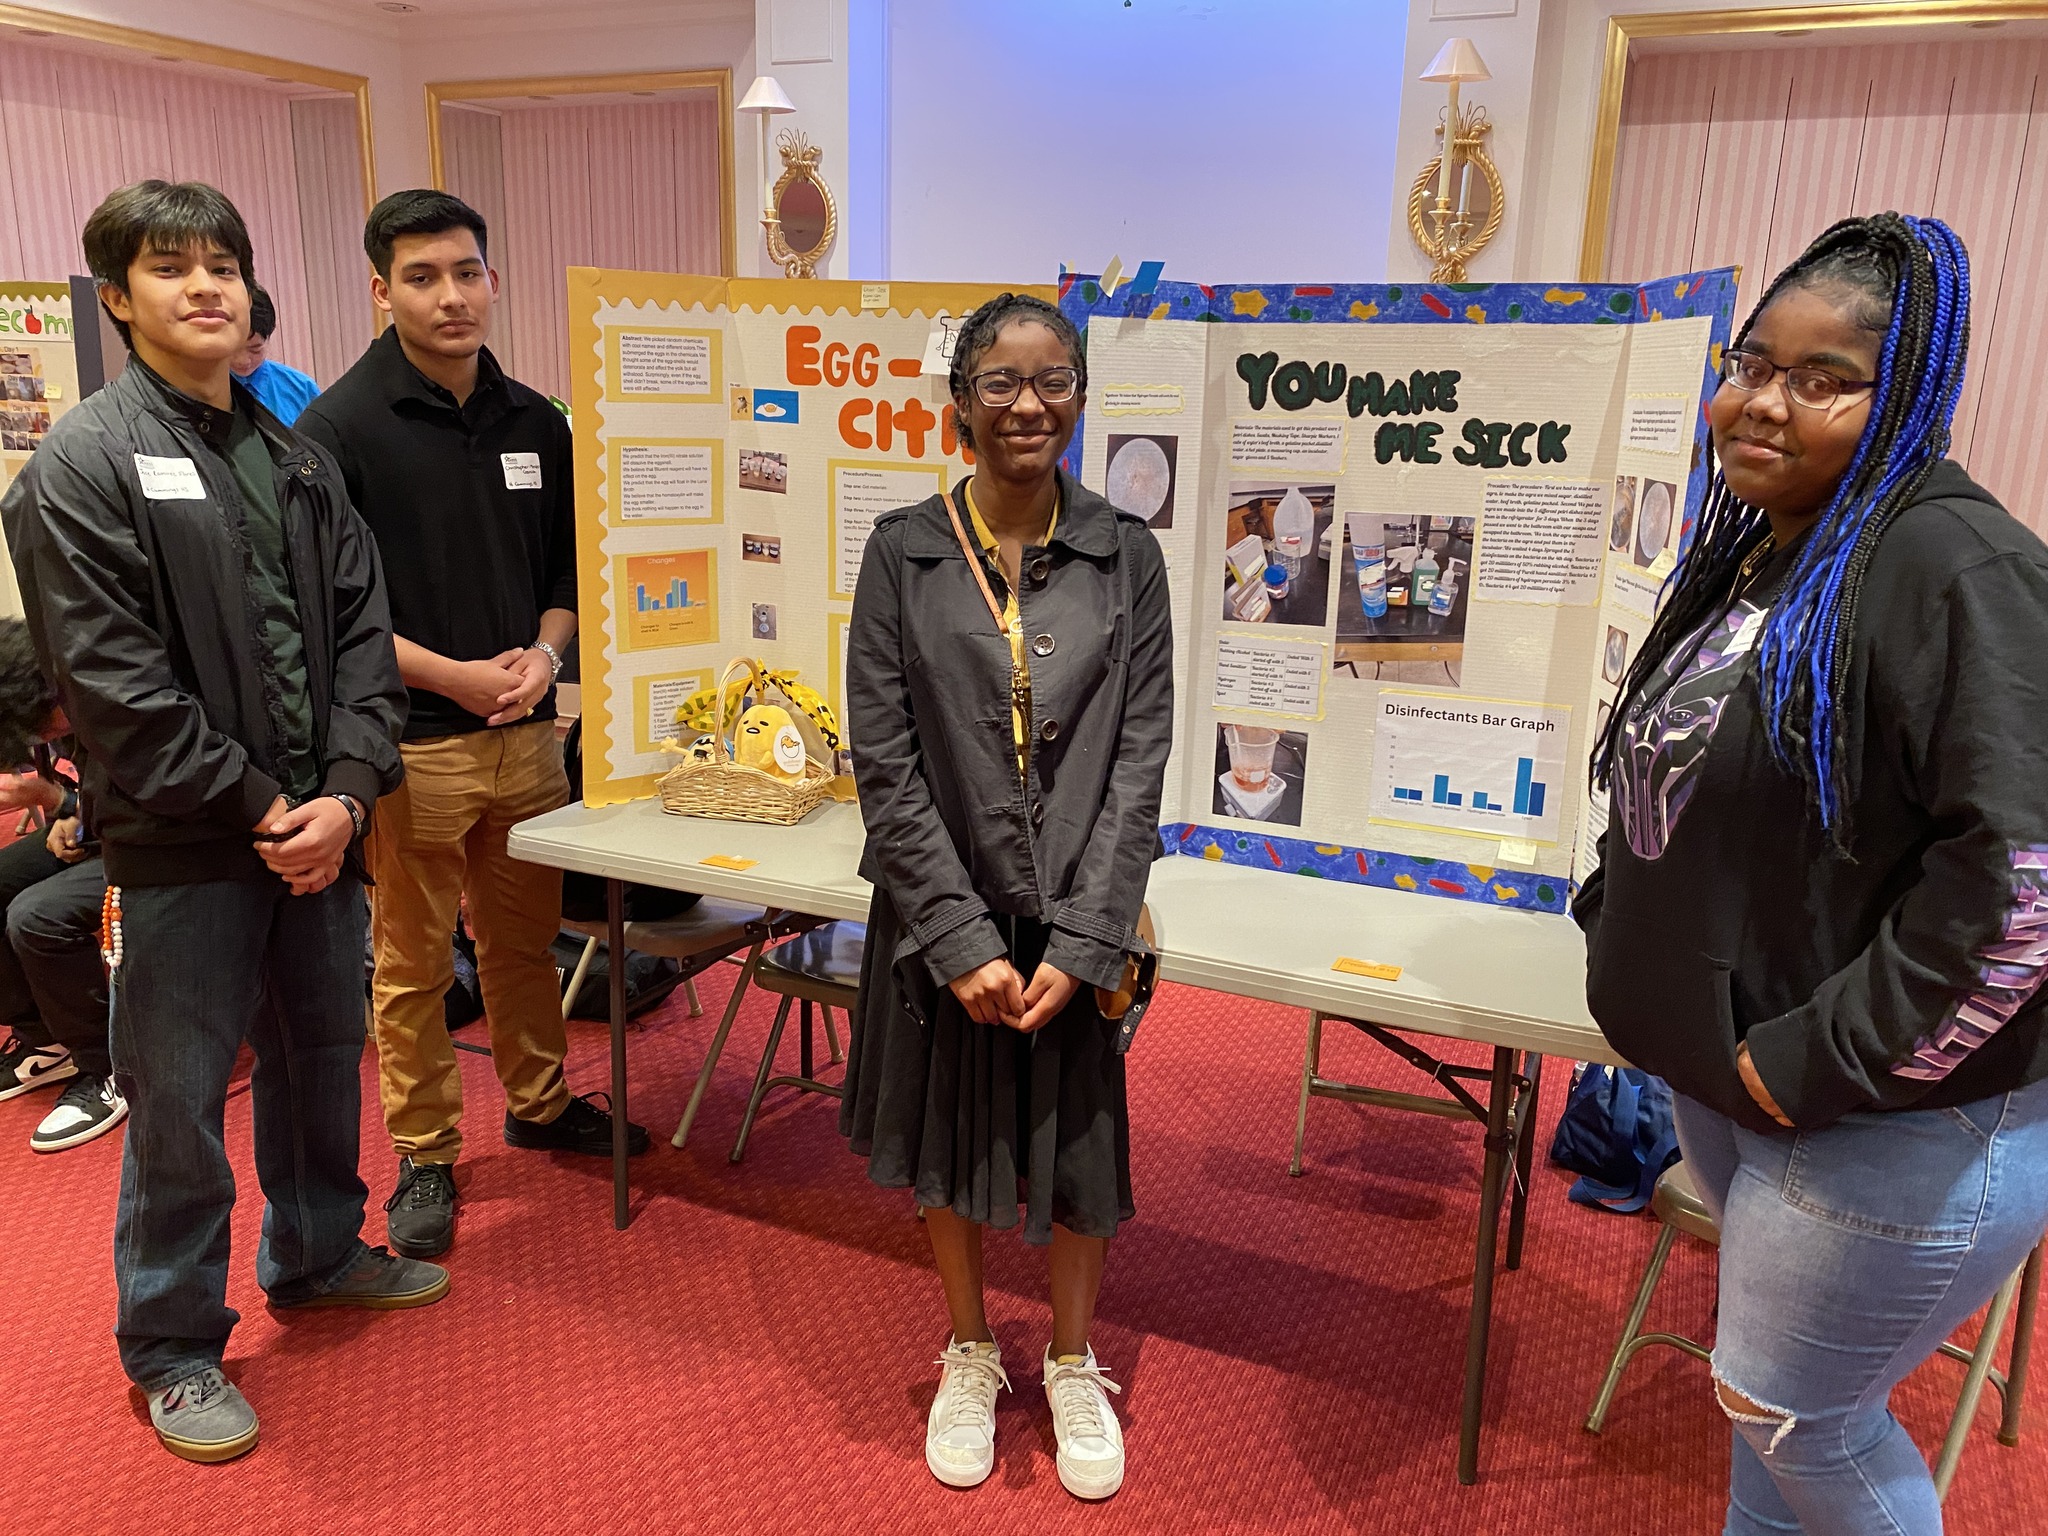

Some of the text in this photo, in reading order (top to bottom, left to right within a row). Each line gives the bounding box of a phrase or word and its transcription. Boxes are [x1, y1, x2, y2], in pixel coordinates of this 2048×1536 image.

[1236, 351, 1461, 418] YOU MAKE
[1374, 418, 1572, 469] ME SICK
[1385, 704, 1555, 733] Disinfectants Bar Graph
